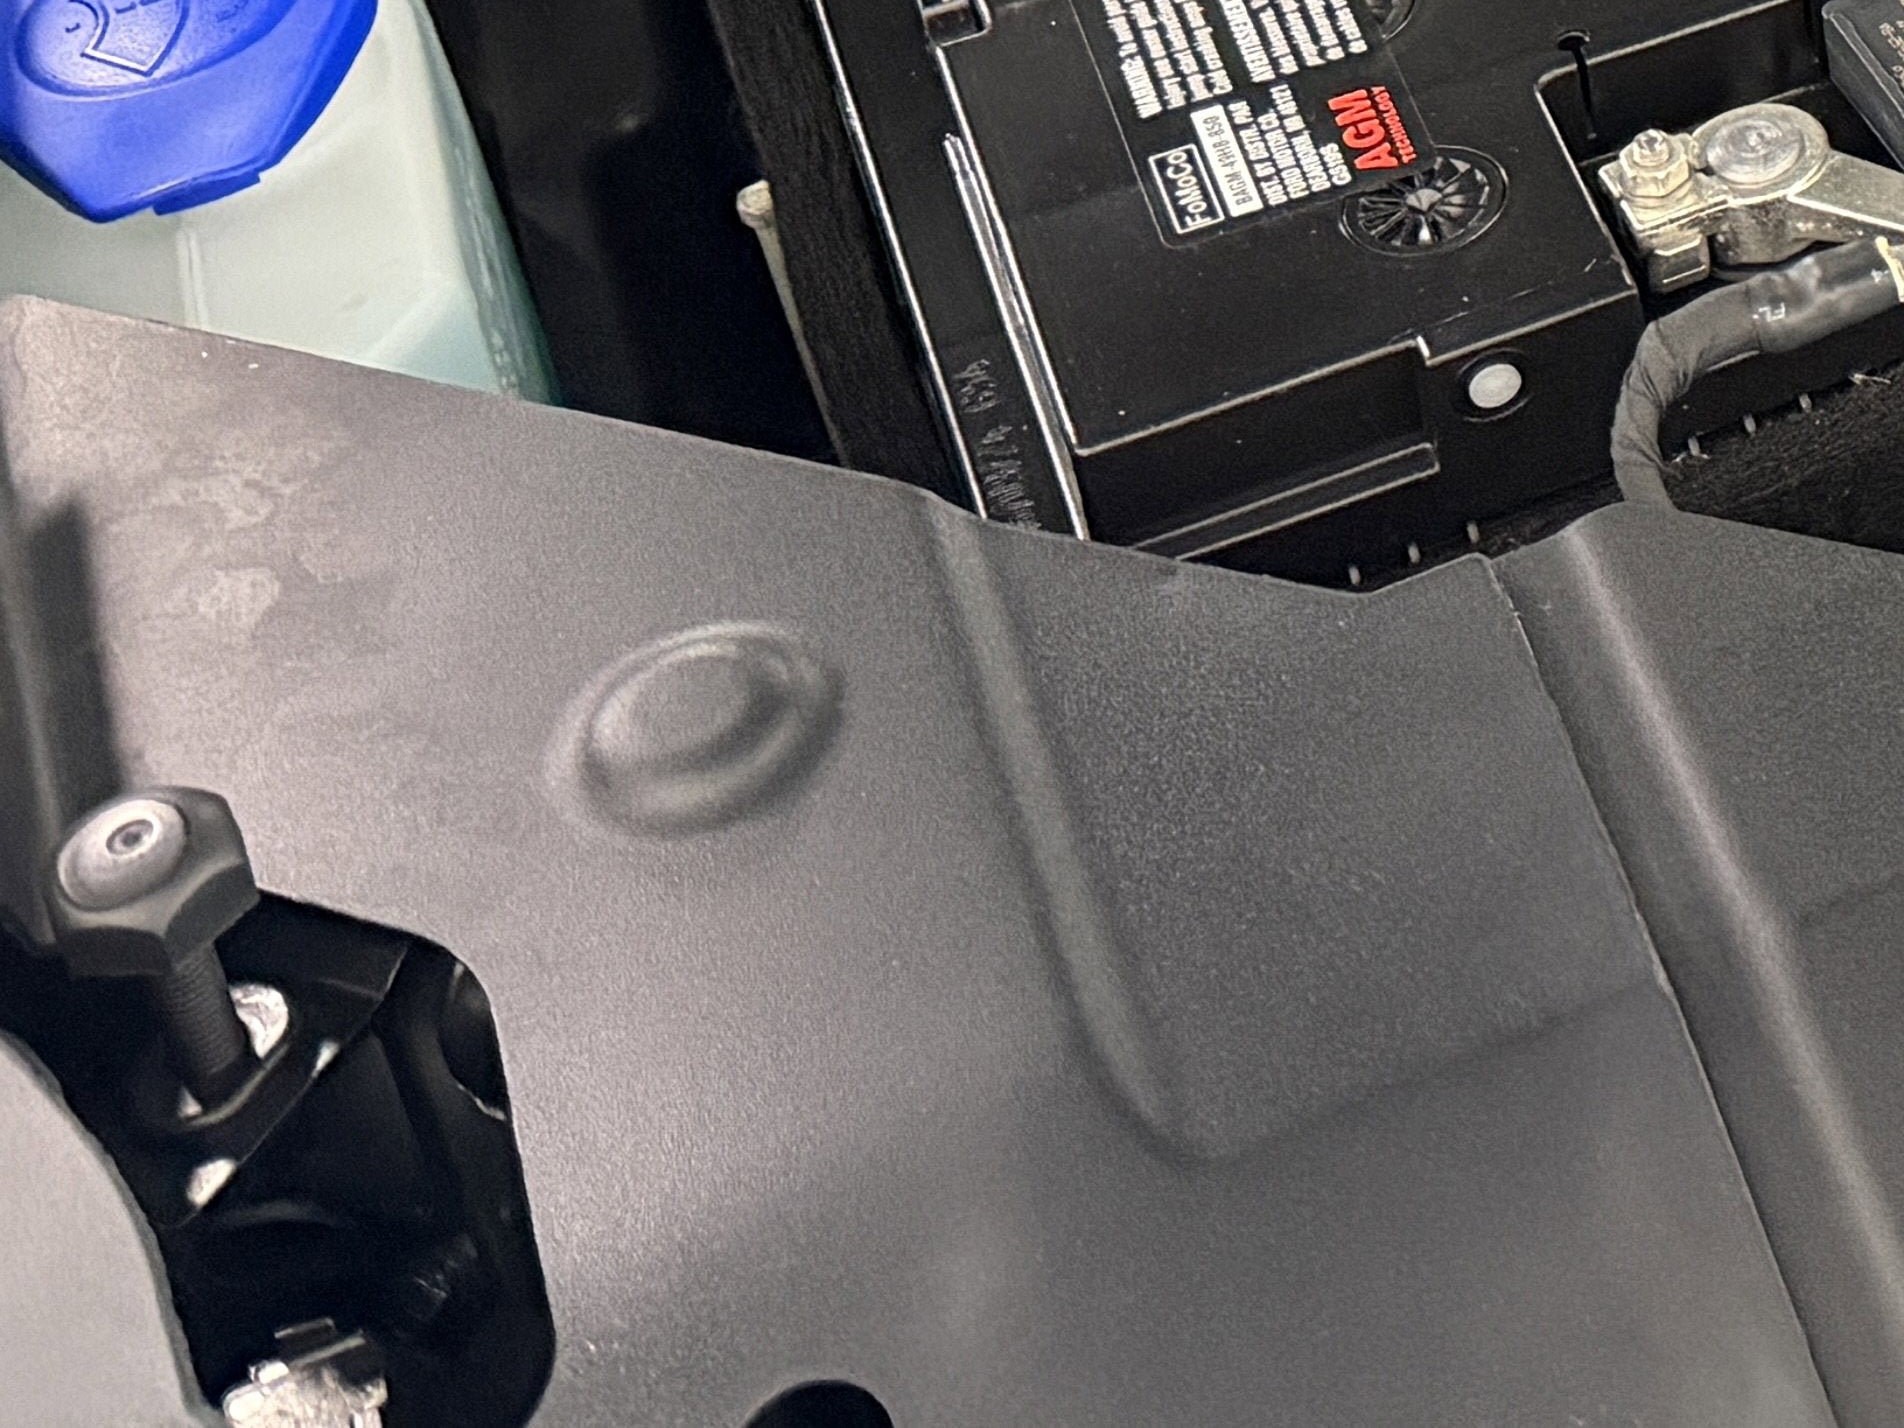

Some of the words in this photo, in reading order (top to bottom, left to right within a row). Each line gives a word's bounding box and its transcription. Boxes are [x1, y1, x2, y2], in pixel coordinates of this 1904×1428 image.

[1328, 89, 1398, 169] AGM
[1371, 86, 1415, 162] TECHNOLOGY
[1165, 148, 1211, 229] FoMoCo
